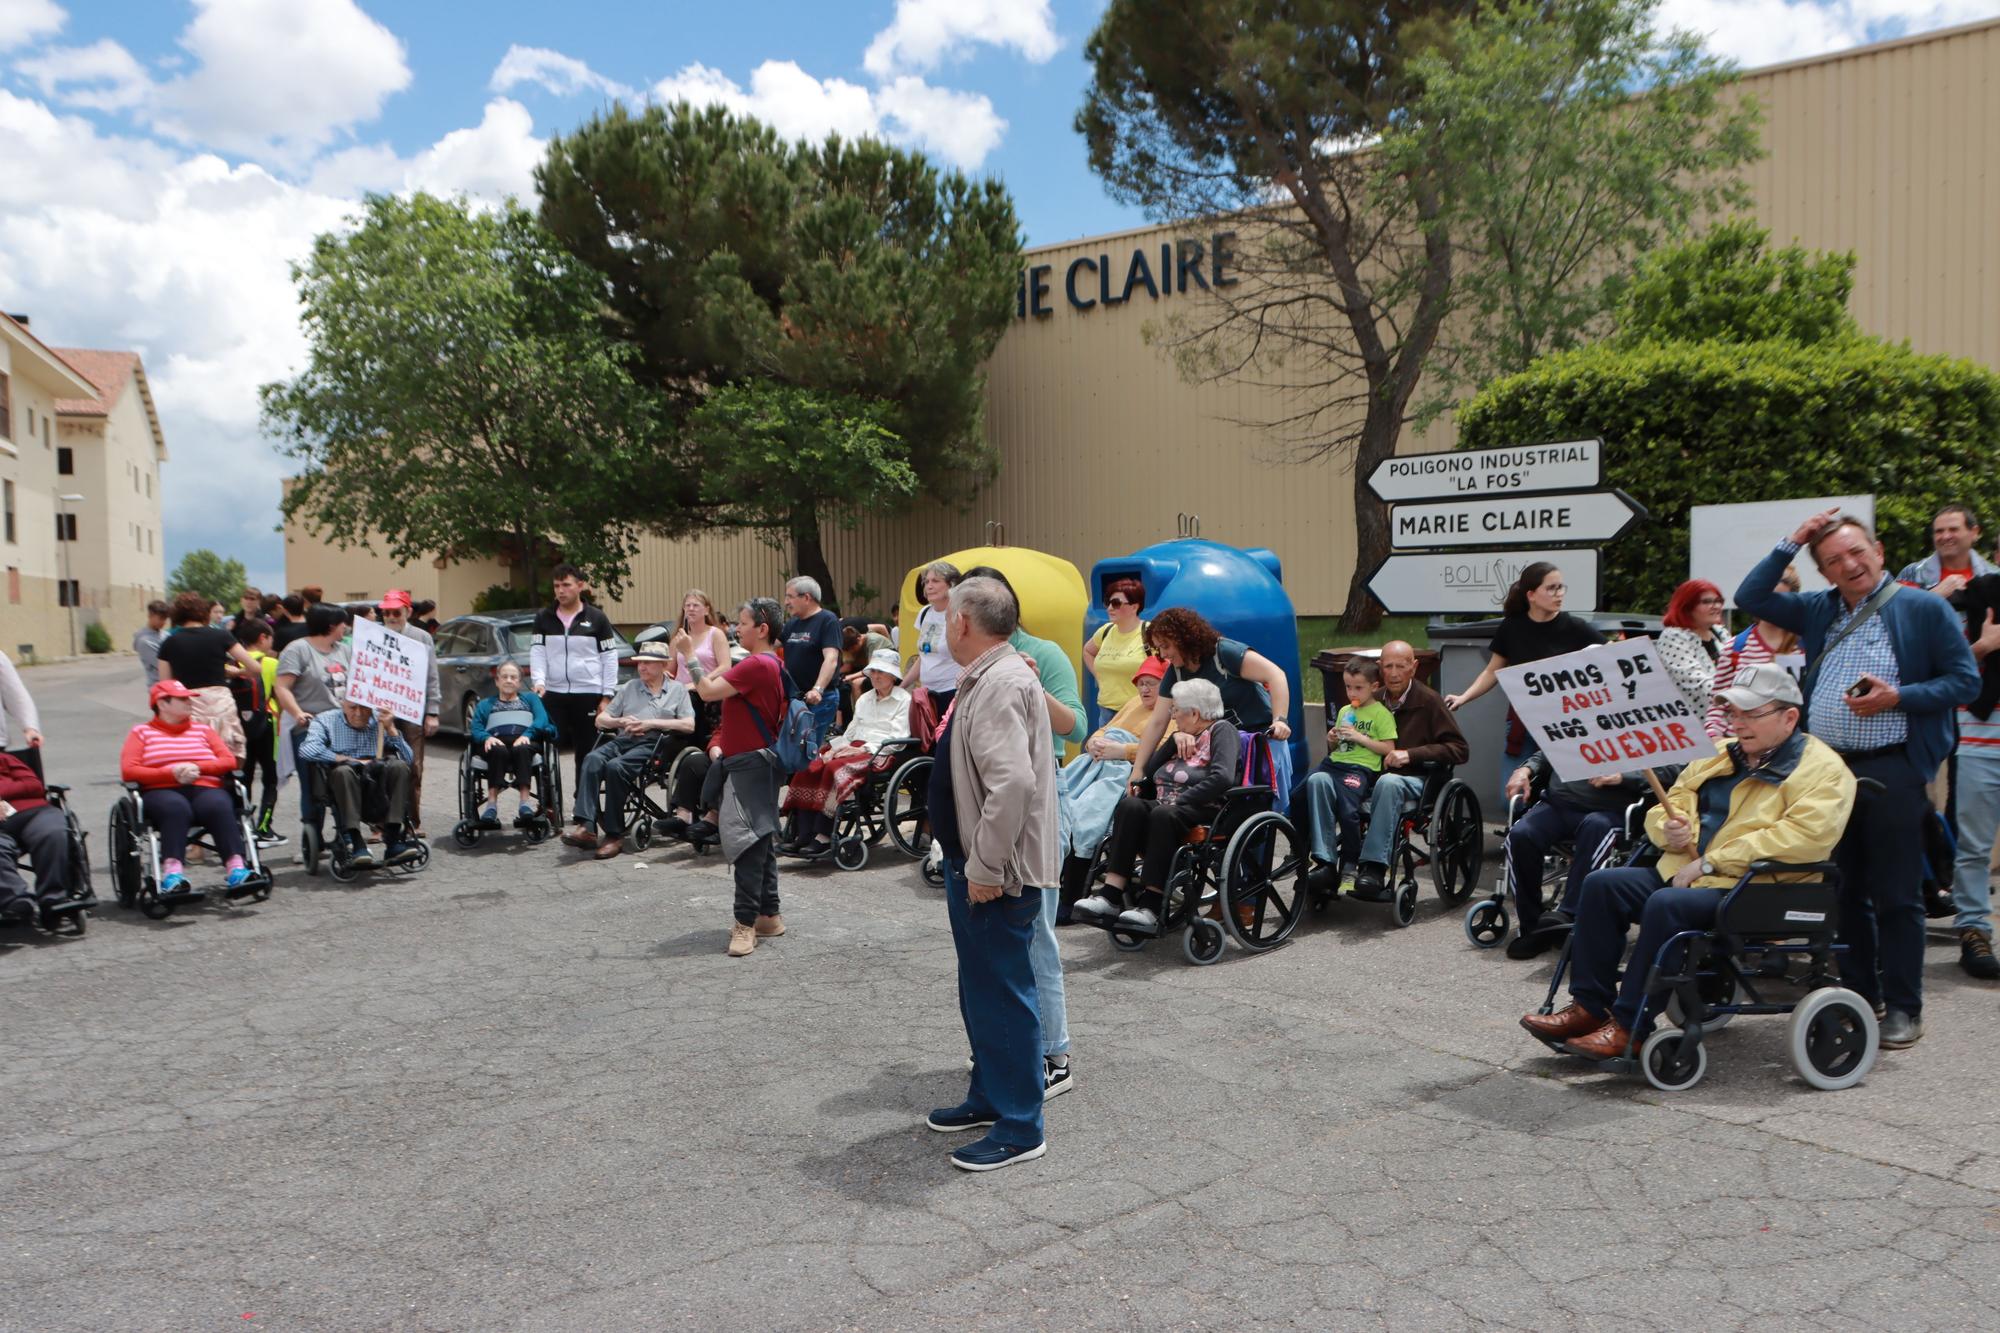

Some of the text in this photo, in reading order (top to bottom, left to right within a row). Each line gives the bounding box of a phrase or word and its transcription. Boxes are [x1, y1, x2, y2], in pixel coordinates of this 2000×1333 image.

[1066, 231, 1238, 310] CLAIRE
[1390, 446, 1590, 477] POLIGONO INDUSTRIAL
[1450, 471, 1530, 491] "LA FOS"
[1400, 508, 1571, 536] MARIE CLAIRE
[357, 651, 379, 669] ELS
[354, 668, 366, 683] EL
[1524, 654, 1653, 696] SOMOS DE
[1621, 680, 1637, 700] Y
[1542, 700, 1690, 742] NOS QUEREMOS
[1579, 722, 1696, 765] QUEDAR
